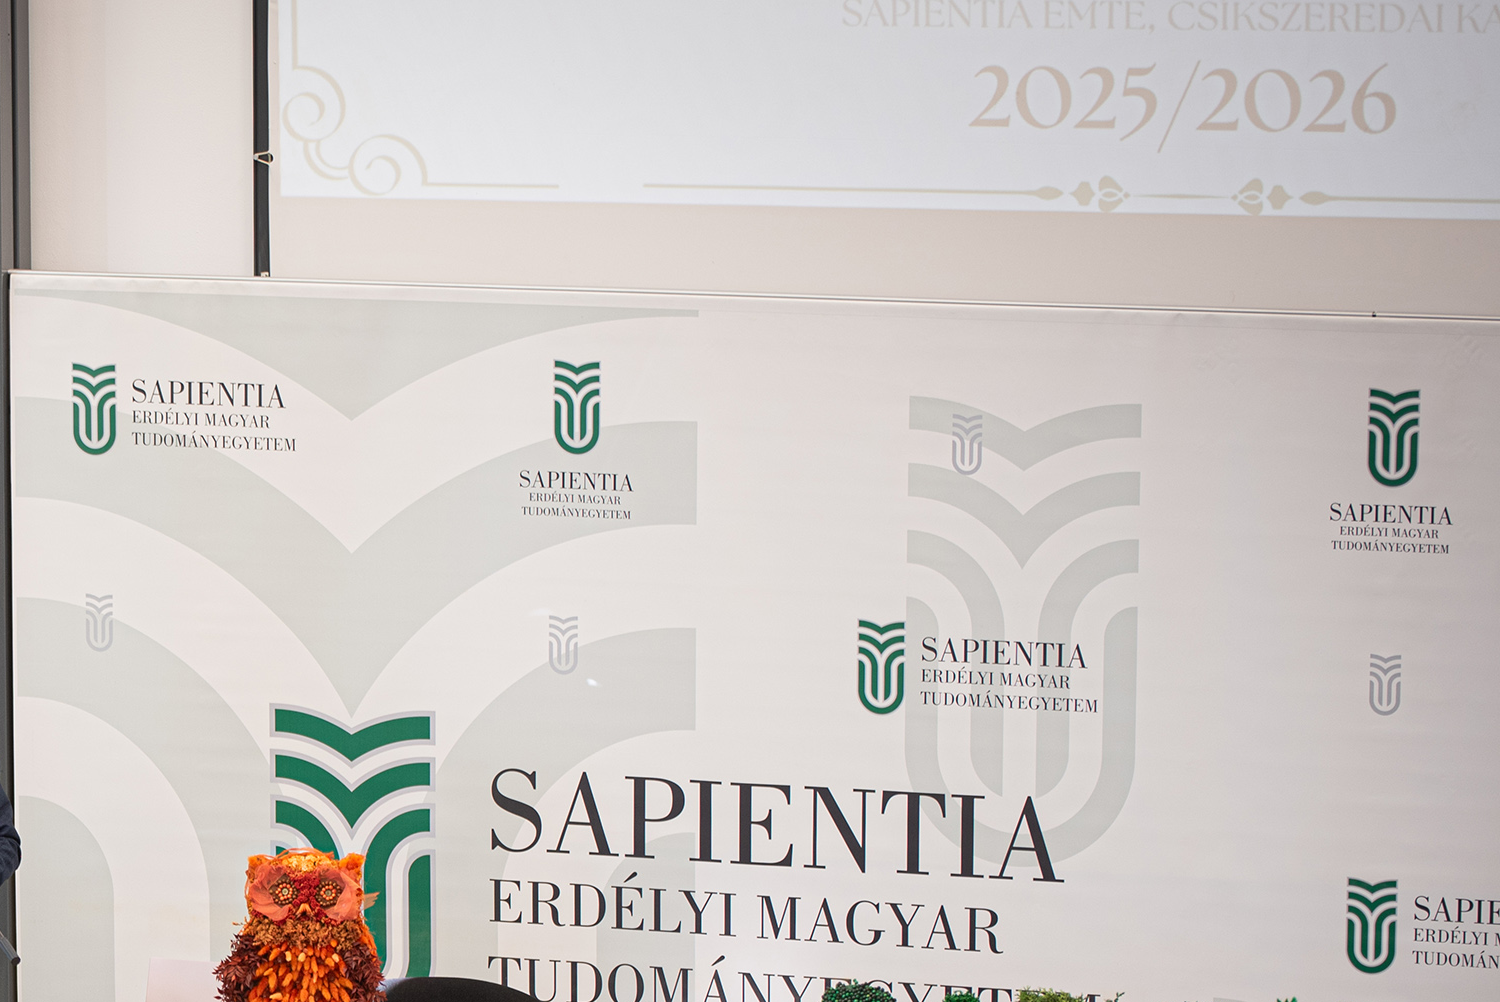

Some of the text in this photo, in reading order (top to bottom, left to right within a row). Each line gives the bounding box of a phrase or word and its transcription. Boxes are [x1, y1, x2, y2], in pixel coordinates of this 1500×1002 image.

[841, 0, 1033, 29] SAPIENTIA
[968, 59, 1397, 154] 2025/2026
[131, 378, 286, 409] SAPIENTIA
[131, 406, 270, 429] ERDÉLYI MAGYAR
[131, 430, 297, 453] TUDOMÁNYEGYETEM
[518, 469, 634, 493] SAPIENTIA
[528, 489, 622, 506] ERDÉLYI MAGYAR
[520, 503, 632, 520] TUDOMÁNYEGYETEM
[1328, 502, 1454, 527] SAPIENTIA
[1338, 524, 1440, 540] ERDÉLYI MAGYAR
[1330, 537, 1451, 555] TUDOMÁNYEGYETEM
[920, 635, 1089, 670] SAPIENTIA
[920, 665, 1071, 691] ERDÉLYI MAGYAR
[919, 689, 1099, 714] TUDOMÁNYEGYETEM
[489, 767, 1066, 884] SAPIENTIA
[488, 871, 1005, 955] ERDÉLYI MAGYAR
[1412, 894, 1500, 926] SAPIE
[1412, 925, 1489, 947] ERDÉLYI
[1411, 950, 1500, 970] TUDOMÁN
